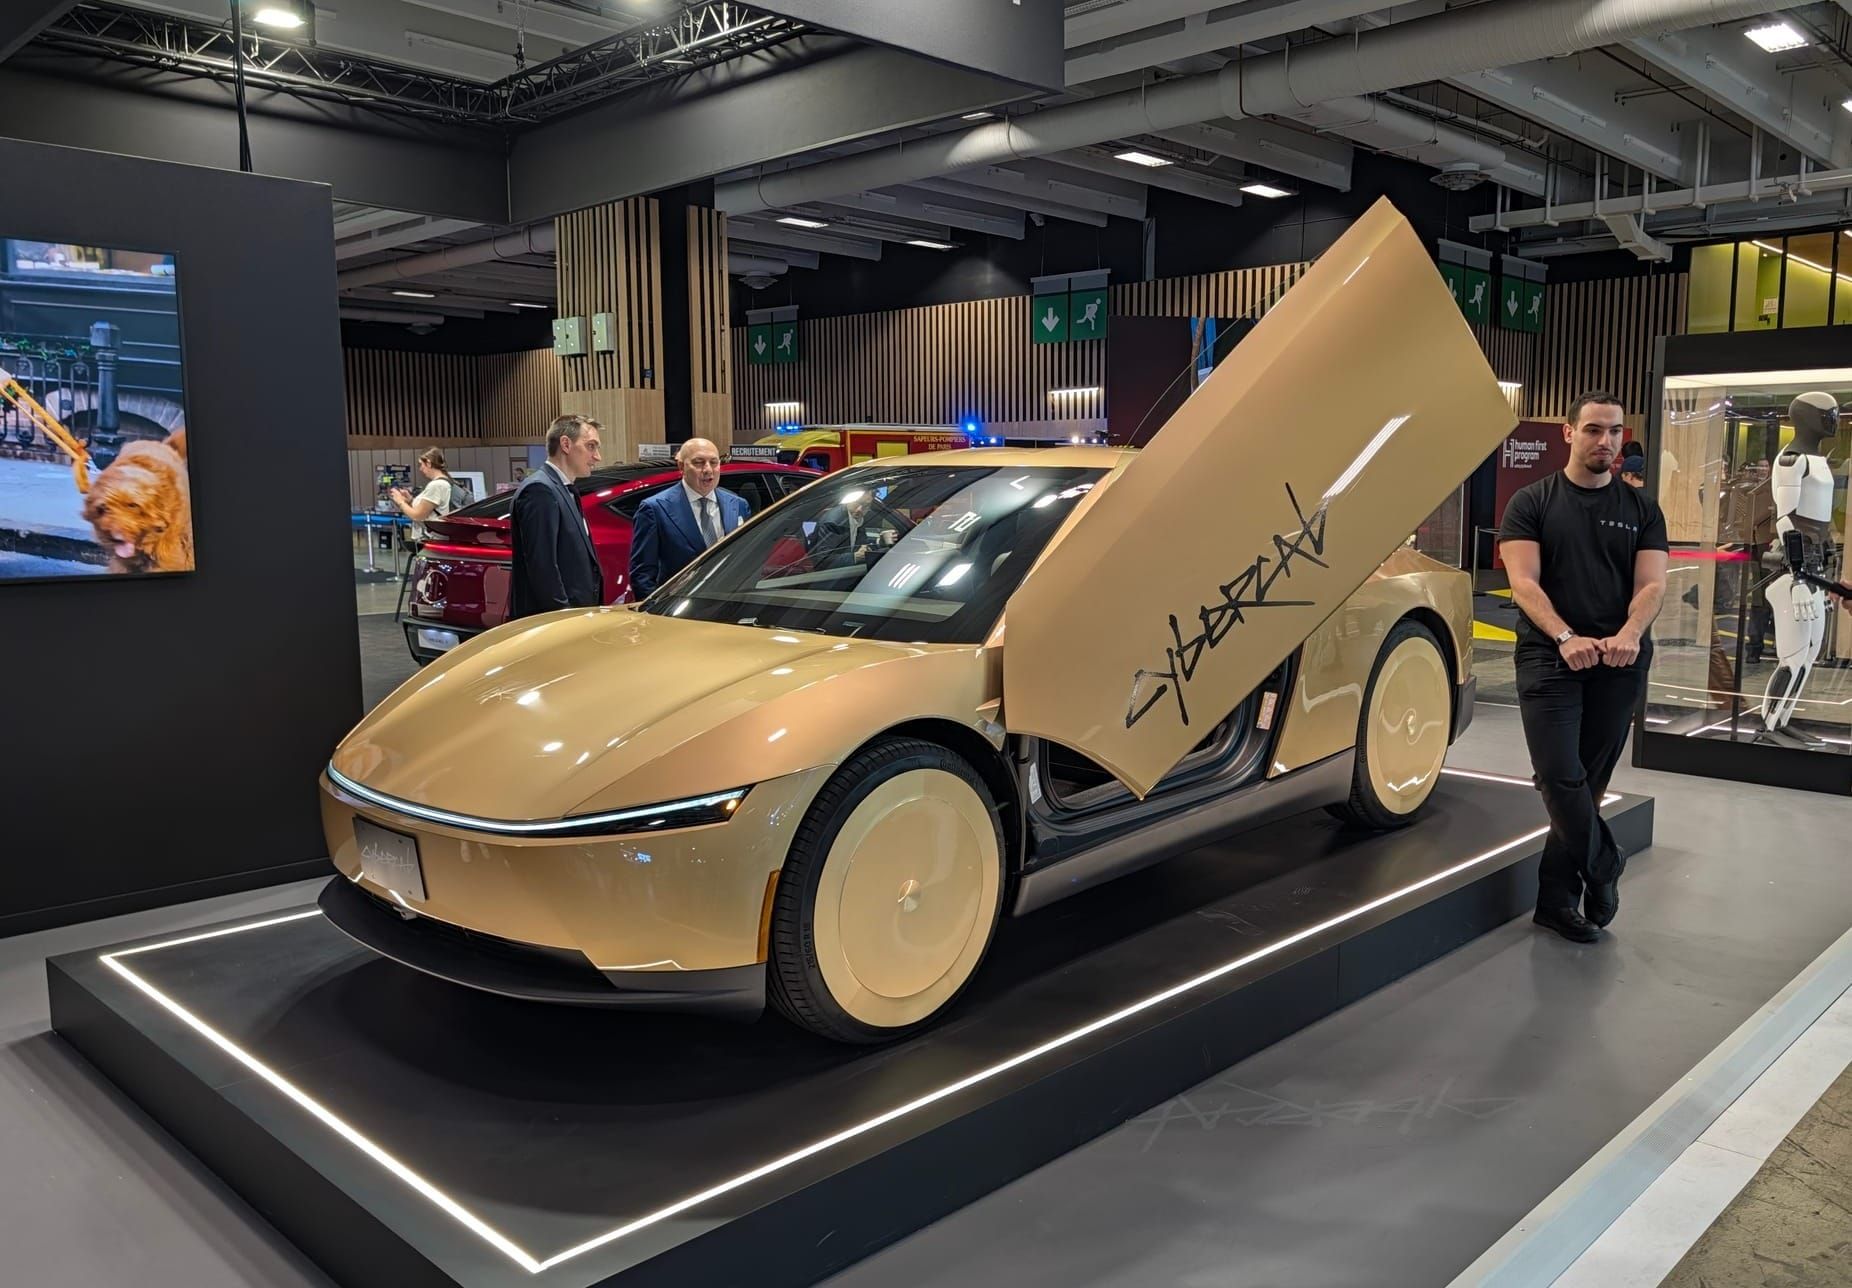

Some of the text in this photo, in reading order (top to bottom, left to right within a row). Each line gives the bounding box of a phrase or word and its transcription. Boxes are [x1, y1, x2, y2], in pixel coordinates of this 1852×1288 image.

[1515, 439, 1547, 451] human first
[731, 447, 776, 457] RECRUTEMENT
[1514, 452, 1540, 463] program
[1599, 519, 1638, 532] TESLA
